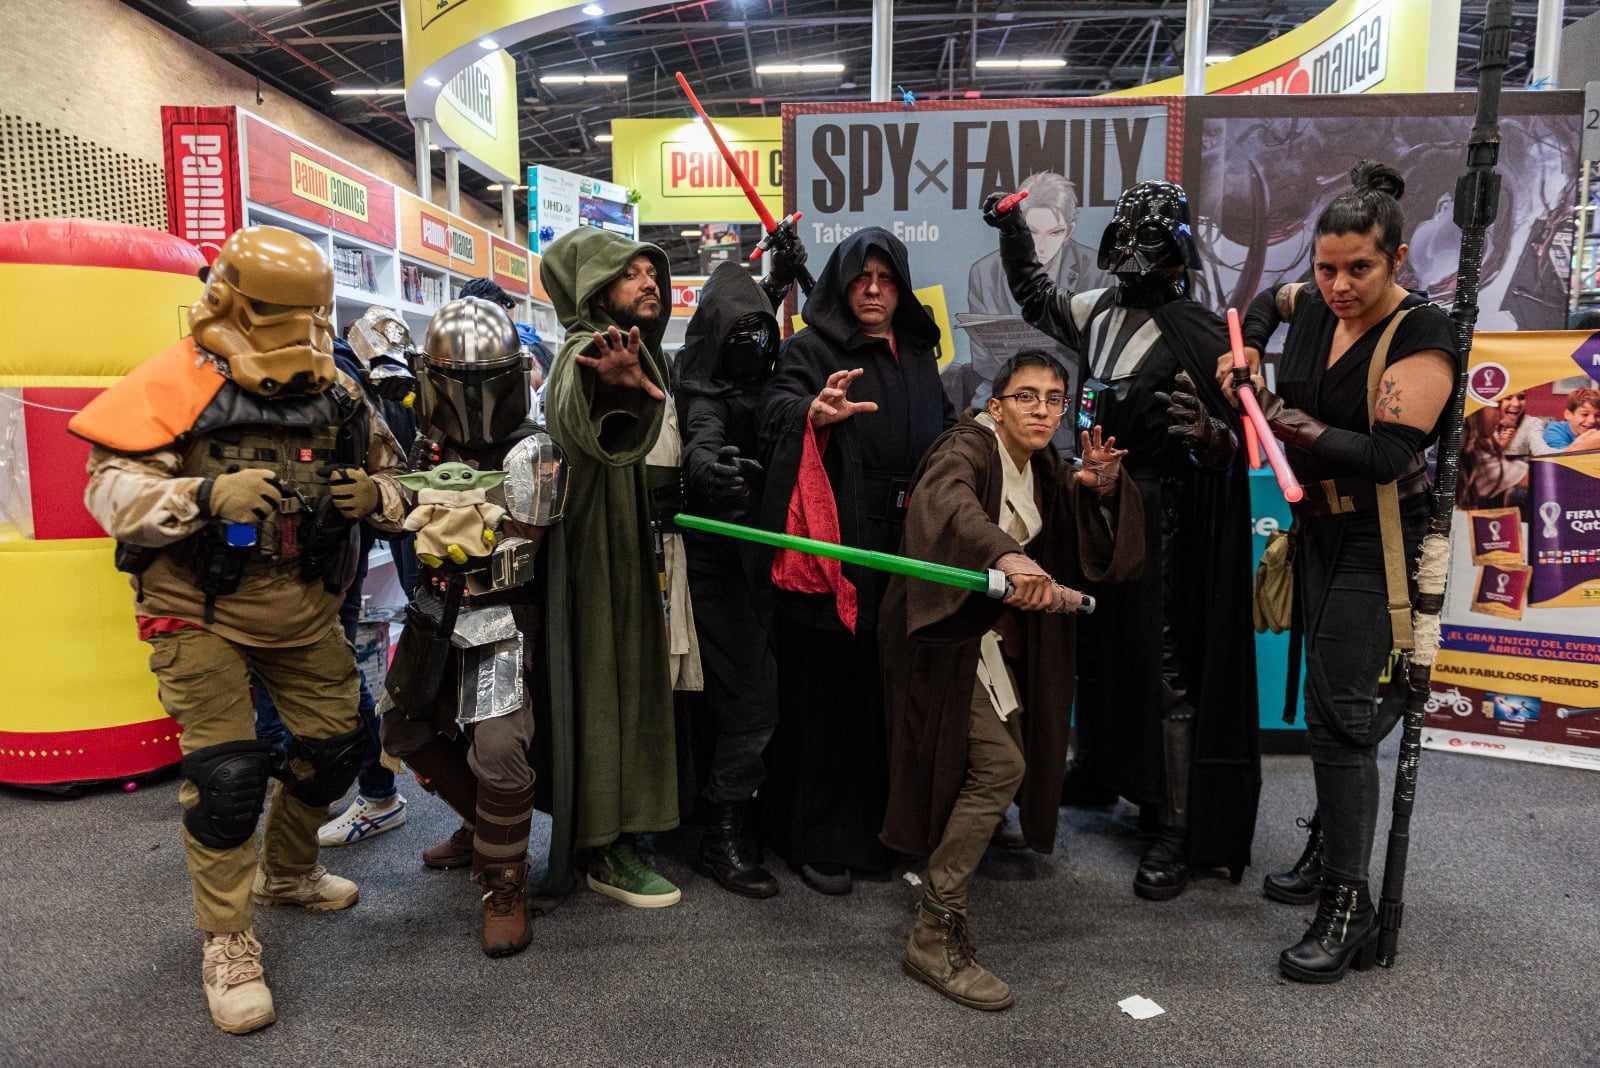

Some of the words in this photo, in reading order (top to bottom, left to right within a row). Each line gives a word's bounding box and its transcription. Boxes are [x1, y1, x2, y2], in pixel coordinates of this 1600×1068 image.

[893, 220, 940, 243] Endo
[1566, 510, 1595, 520] FIFA
[1466, 632, 1496, 644] GRAN
[1497, 634, 1538, 648] INICIO
[1541, 639, 1561, 650] DEL
[1435, 664, 1467, 676] GANA
[1469, 667, 1538, 683] FABULOSOS
[1541, 674, 1599, 689] PREMIOS
